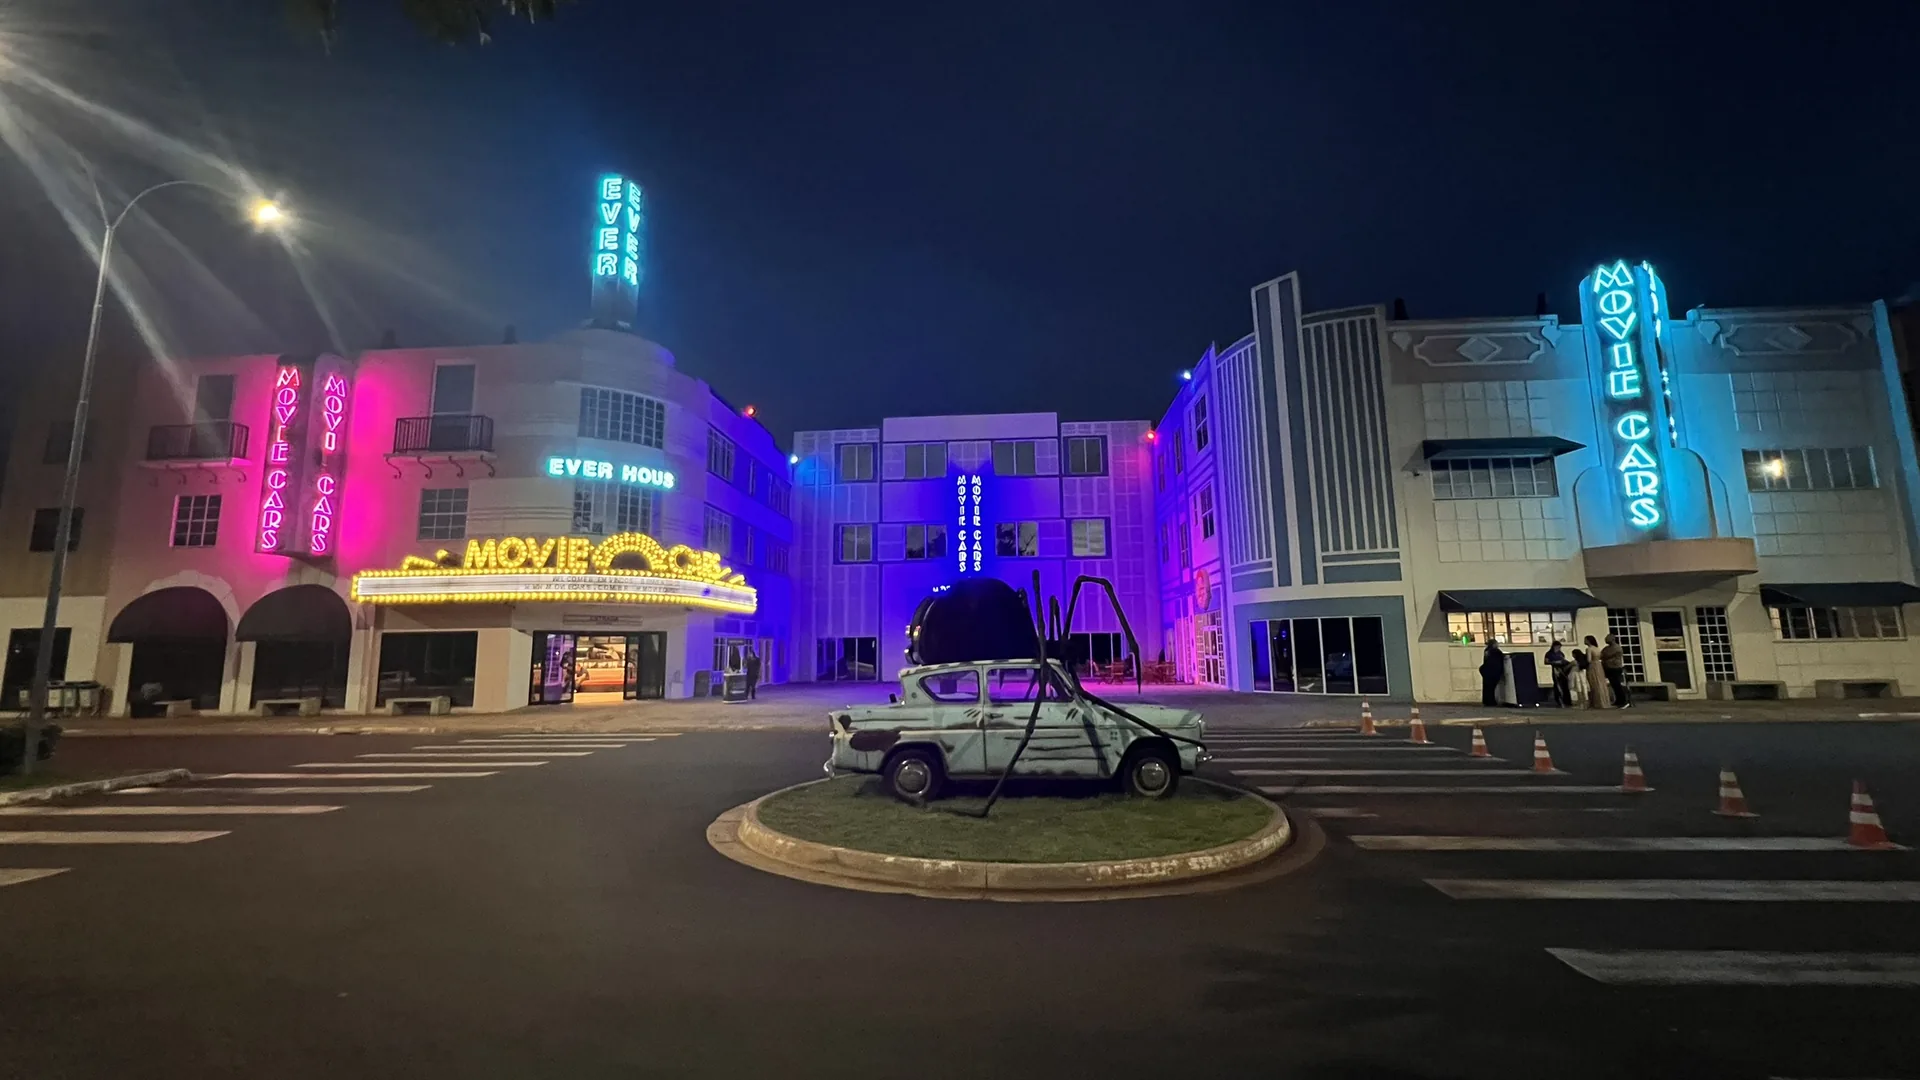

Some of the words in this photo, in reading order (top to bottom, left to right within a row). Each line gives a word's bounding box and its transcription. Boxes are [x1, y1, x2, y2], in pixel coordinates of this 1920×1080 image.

[597, 177, 622, 276] EVER
[624, 182, 641, 286] EVER
[1593, 259, 1641, 397] MOVIE
[548, 457, 614, 480] EVER
[957, 474, 967, 527] MOVIE
[971, 474, 982, 527] MOVIE
[1616, 413, 1661, 526] CARS
[261, 470, 288, 550] CARS
[312, 476, 335, 552] CARS
[464, 535, 590, 569] MOVIE
[958, 529, 967, 573] CARS
[972, 529, 982, 572] CARS
